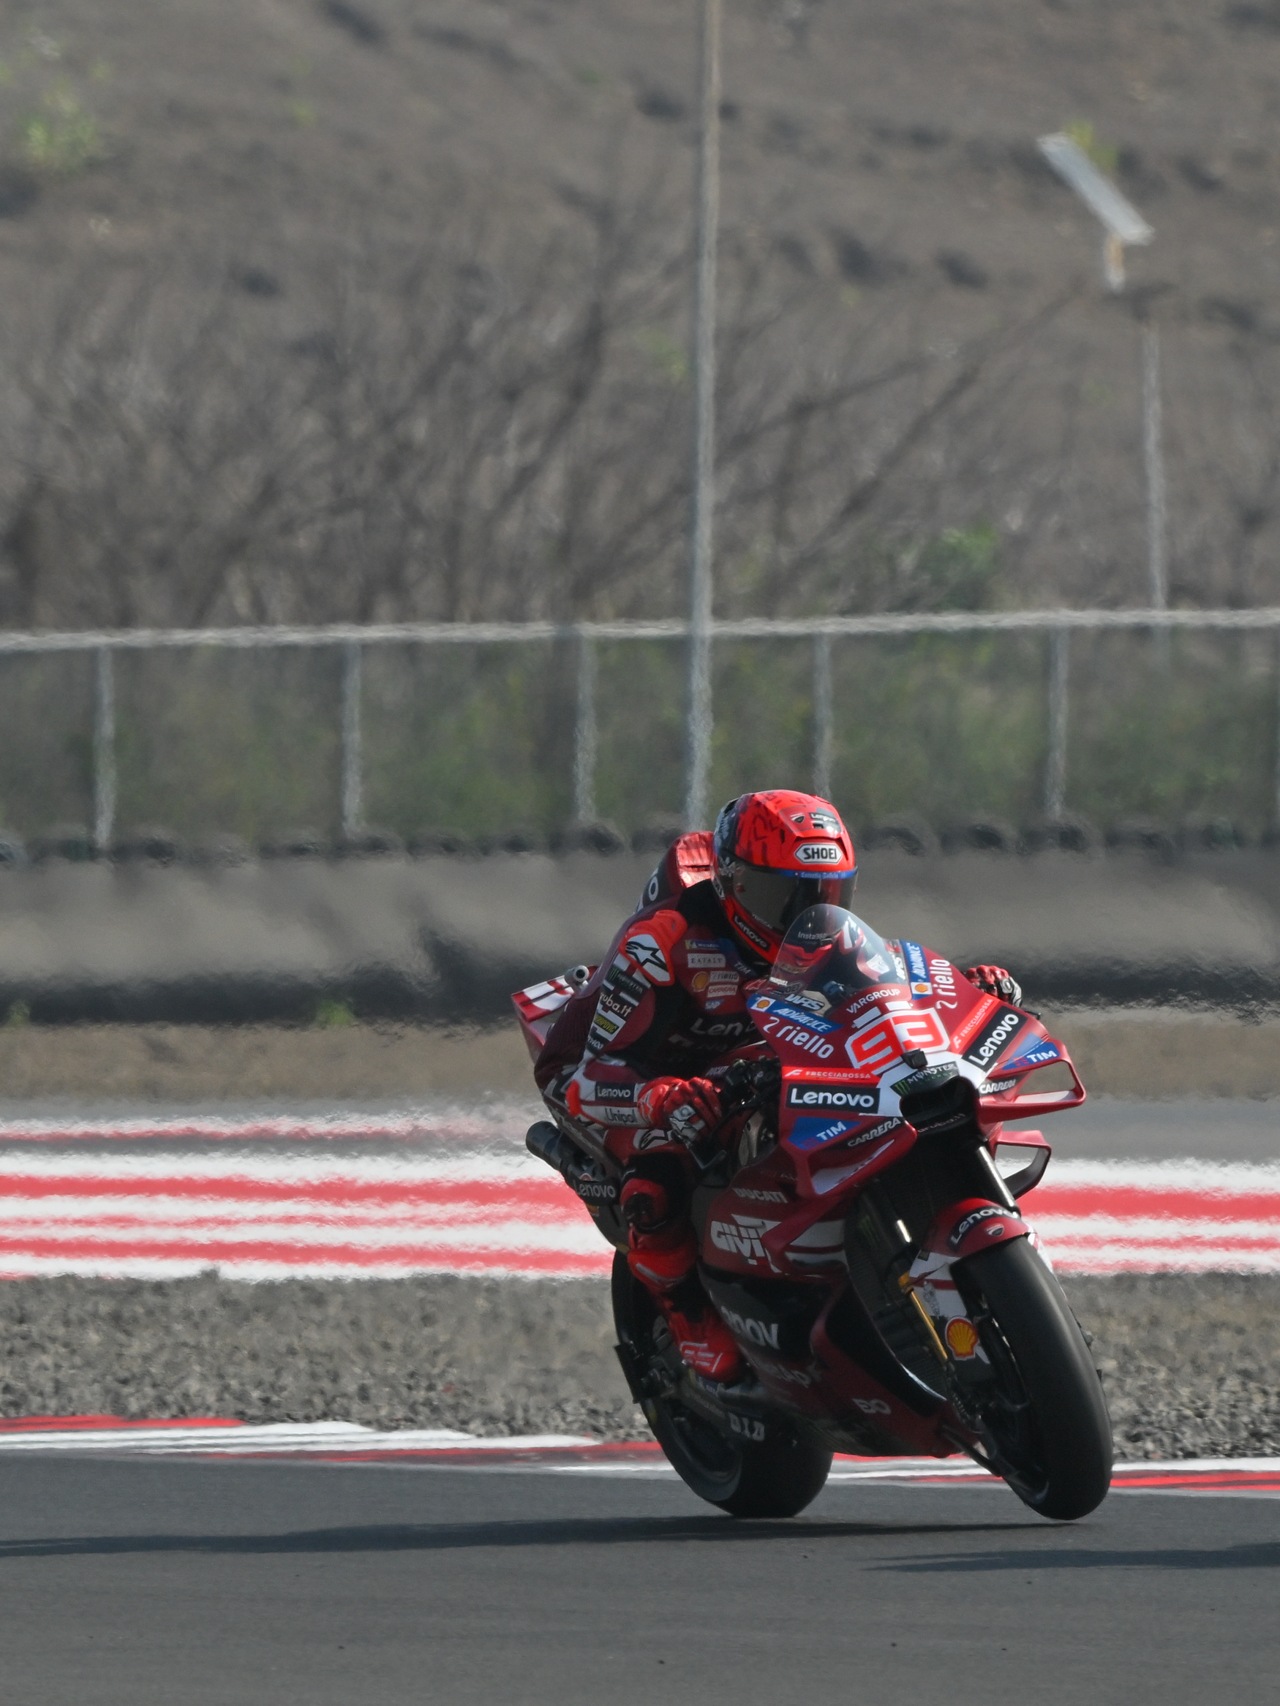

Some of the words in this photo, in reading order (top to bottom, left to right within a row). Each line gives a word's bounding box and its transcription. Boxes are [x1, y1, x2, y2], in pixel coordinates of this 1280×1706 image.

[803, 843, 837, 860] SHOEI
[733, 914, 768, 949] Lenovo
[929, 958, 957, 997] riello
[775, 1025, 835, 1059] riello
[968, 1013, 1019, 1066] Lenovo
[1026, 1050, 1057, 1063] TIM
[805, 1070, 871, 1080] FRECCIAROSSA
[597, 1085, 631, 1098] Lenovo
[790, 1087, 875, 1108] Lenovo
[604, 1107, 637, 1124] Unipol
[816, 1120, 847, 1141] TIM
[847, 1117, 901, 1148] CARRERA
[573, 1179, 617, 1199] Lenovo
[732, 1187, 789, 1204] DUCATI
